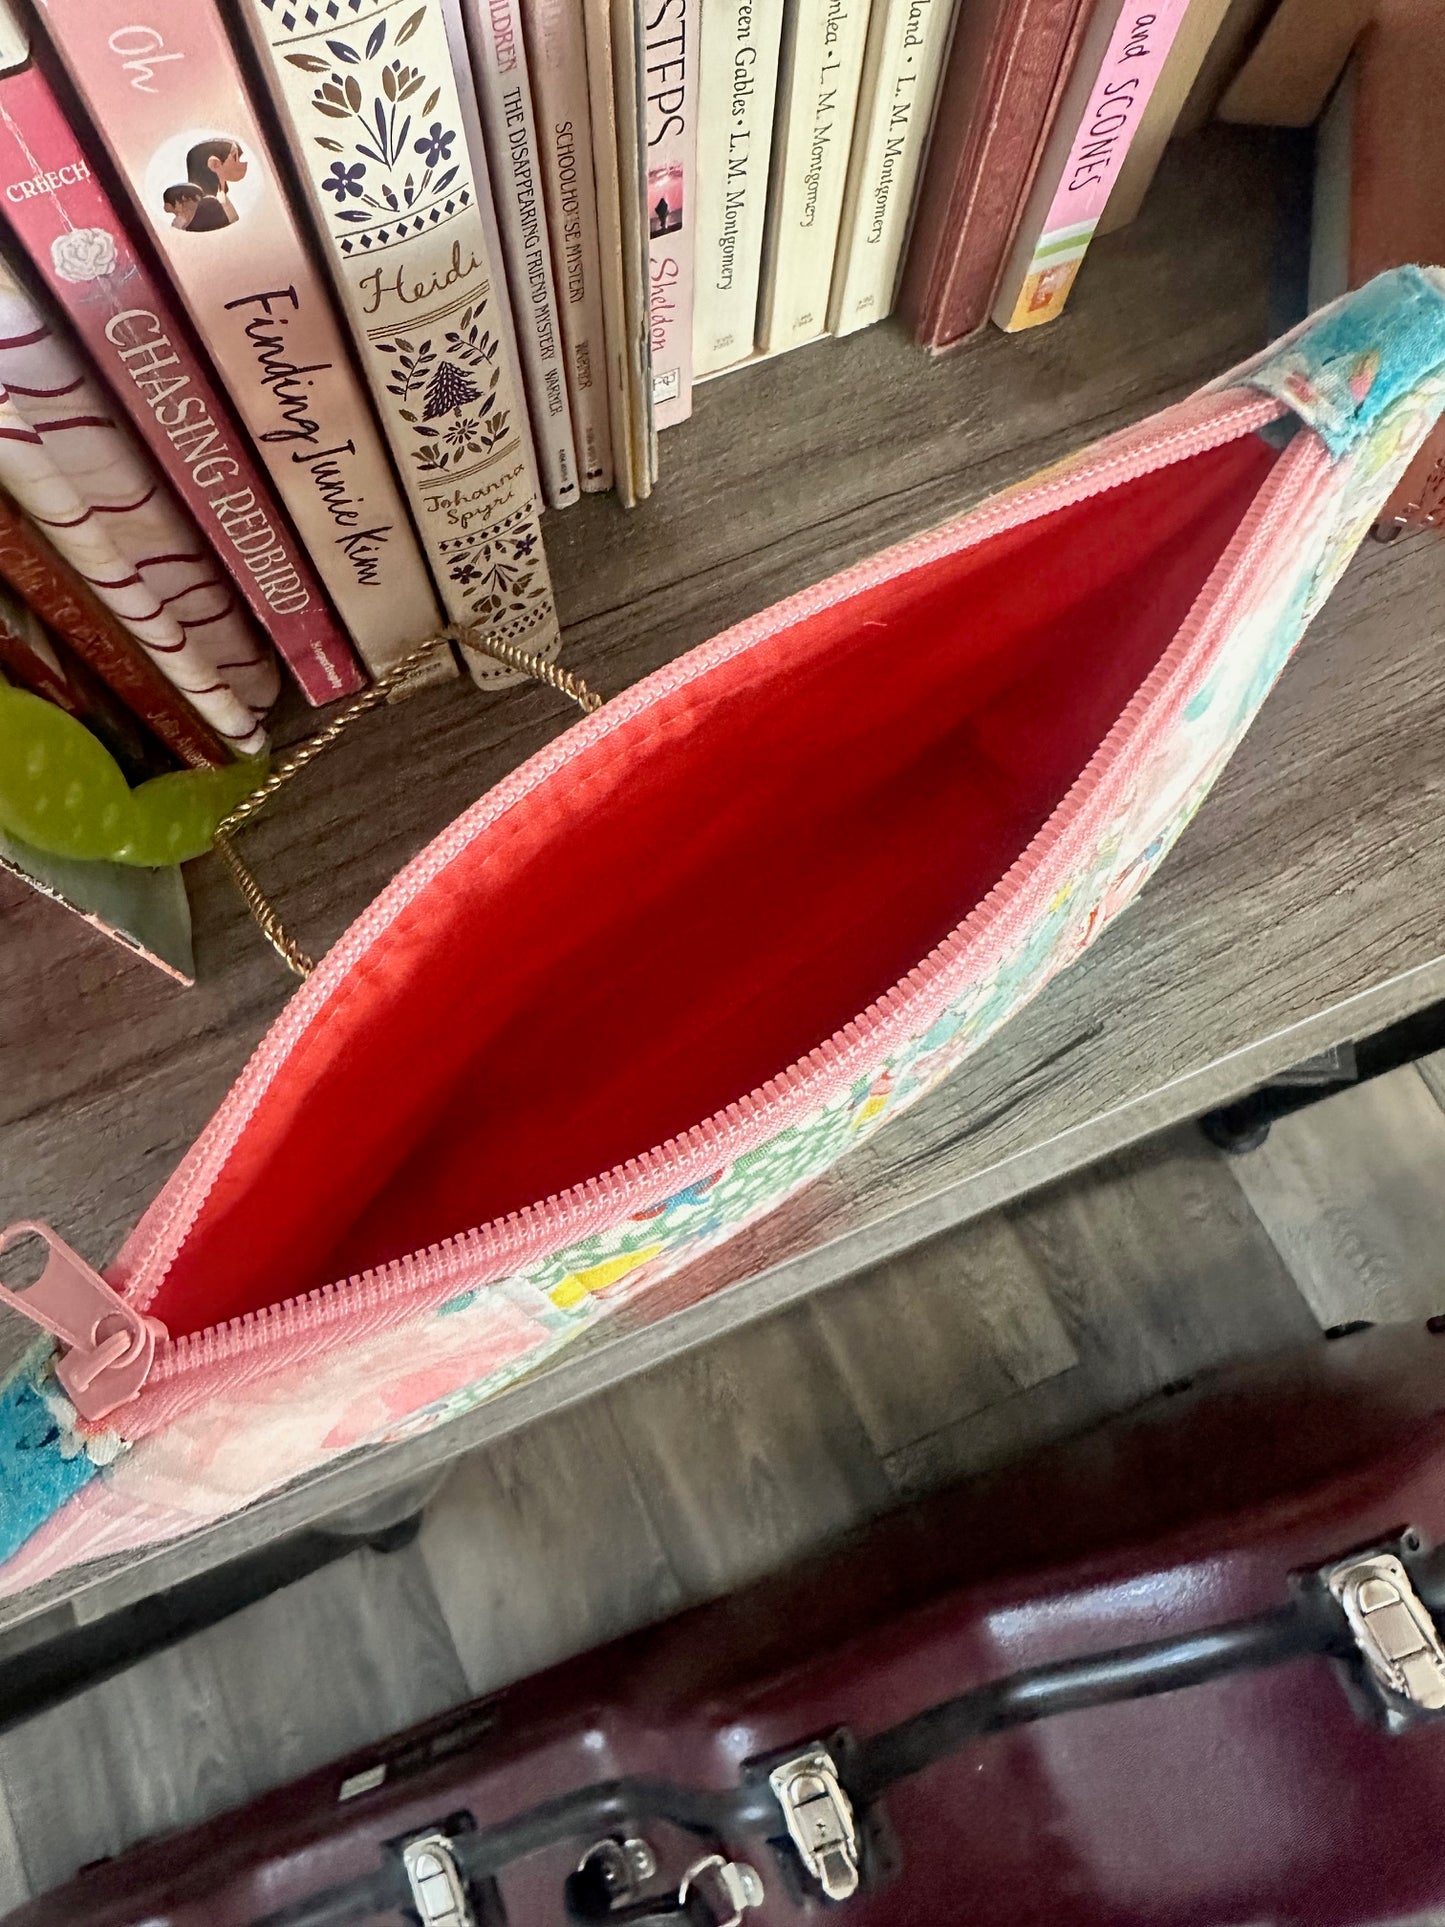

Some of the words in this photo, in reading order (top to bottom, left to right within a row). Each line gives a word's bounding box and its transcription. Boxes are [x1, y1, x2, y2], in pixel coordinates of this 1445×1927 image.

[736, 0, 753, 41] een
[825, 0, 848, 45] nlea
[1117, 14, 1156, 64] and
[108, 25, 186, 94] Oh
[732, 47, 757, 116] Gables
[895, 74, 917, 97] L.
[503, 87, 524, 127] THE
[889, 102, 911, 132] M.
[1068, 77, 1140, 192] SCONES
[727, 154, 748, 185] M.
[729, 130, 751, 153] L.
[6, 160, 92, 203] CREECH
[508, 127, 540, 249] DISAPPEARING
[799, 122, 833, 227] Montgomery
[866, 135, 905, 244] Montgomery
[716, 188, 746, 290] Montgomery
[359, 240, 483, 314] Heidi
[526, 249, 548, 304] FRIEND
[650, 257, 680, 352] Sheldon
[534, 303, 555, 361] MYSTERY
[105, 309, 240, 488] CHASING
[209, 486, 311, 615] REDBIRD
[224, 285, 332, 445] Finding
[292, 439, 363, 527] Junie
[336, 525, 393, 586] Kim
[423, 464, 524, 512] Johanna
